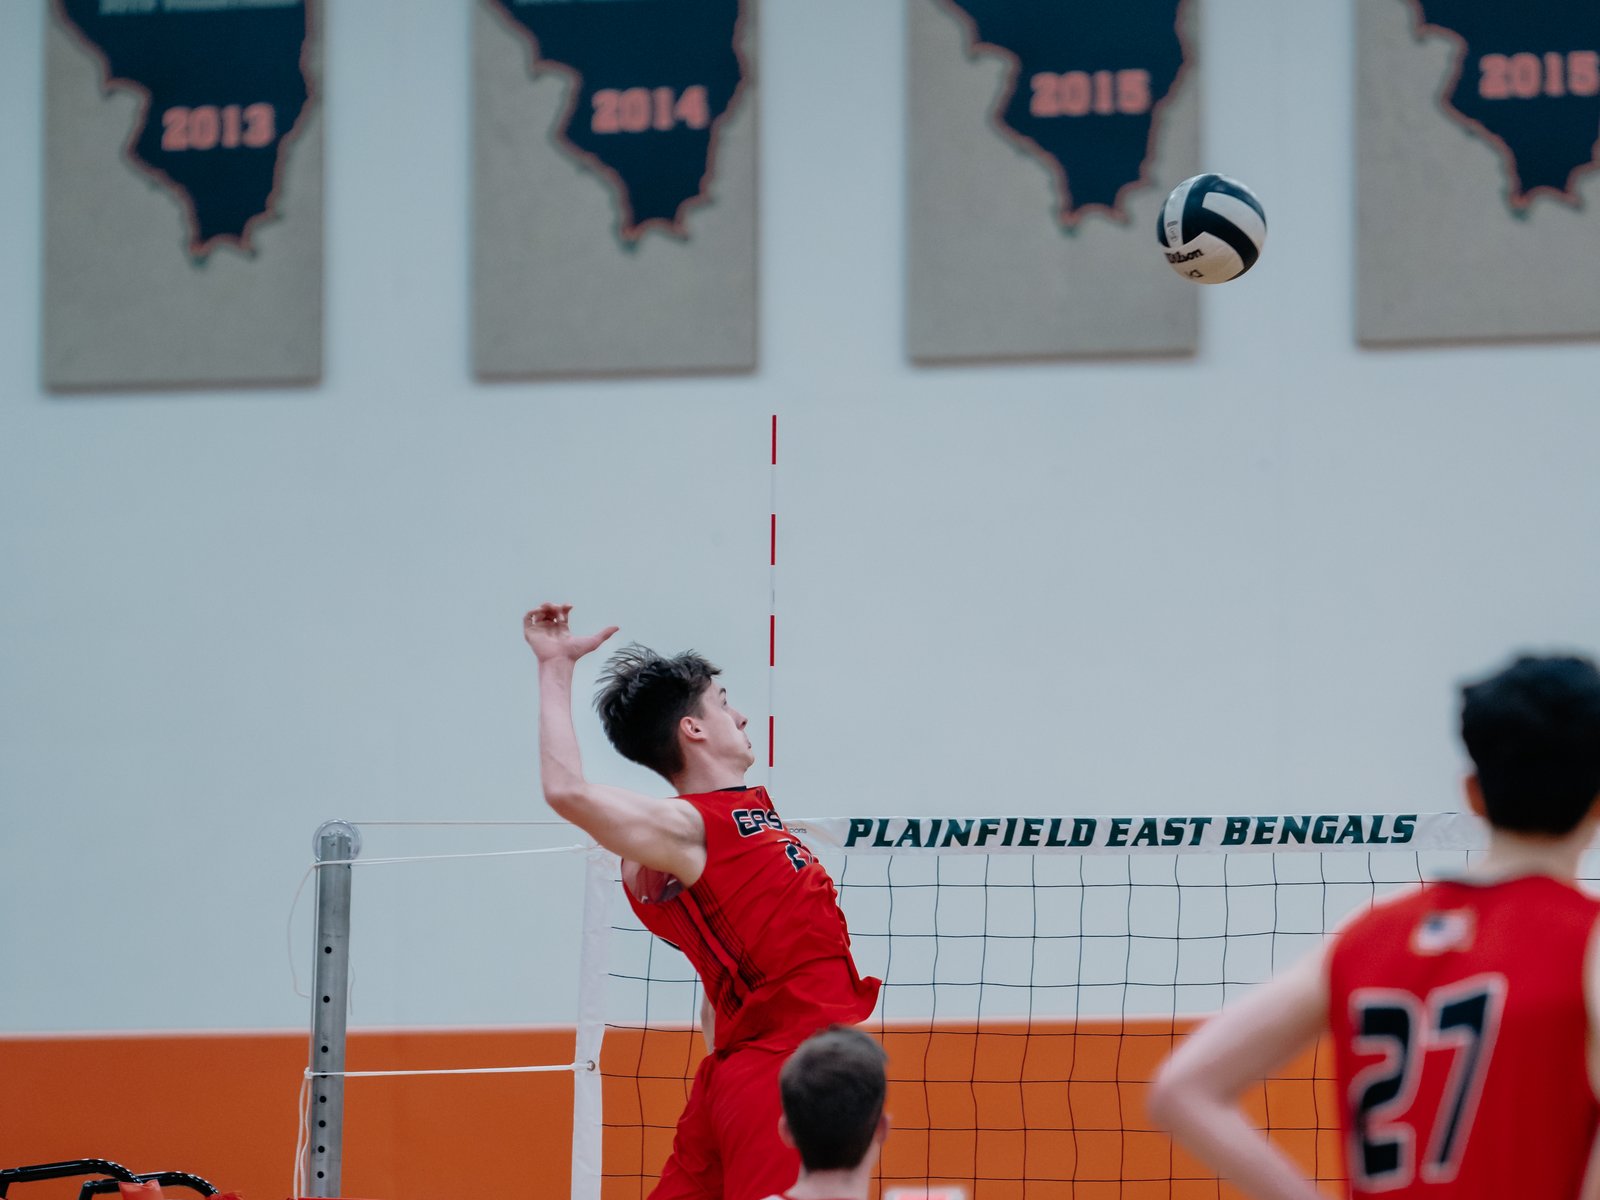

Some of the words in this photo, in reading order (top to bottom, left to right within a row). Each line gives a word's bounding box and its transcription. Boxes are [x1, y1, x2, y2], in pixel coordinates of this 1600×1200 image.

[592, 85, 709, 133] 2014
[1030, 69, 1150, 117] 2015
[162, 103, 275, 151] 2013
[732, 809, 783, 838] EAS
[844, 818, 1097, 847] PLAINFIELD
[1104, 817, 1213, 847] EAST
[1220, 814, 1417, 846] BENGALS
[1348, 972, 1508, 1193] 27
